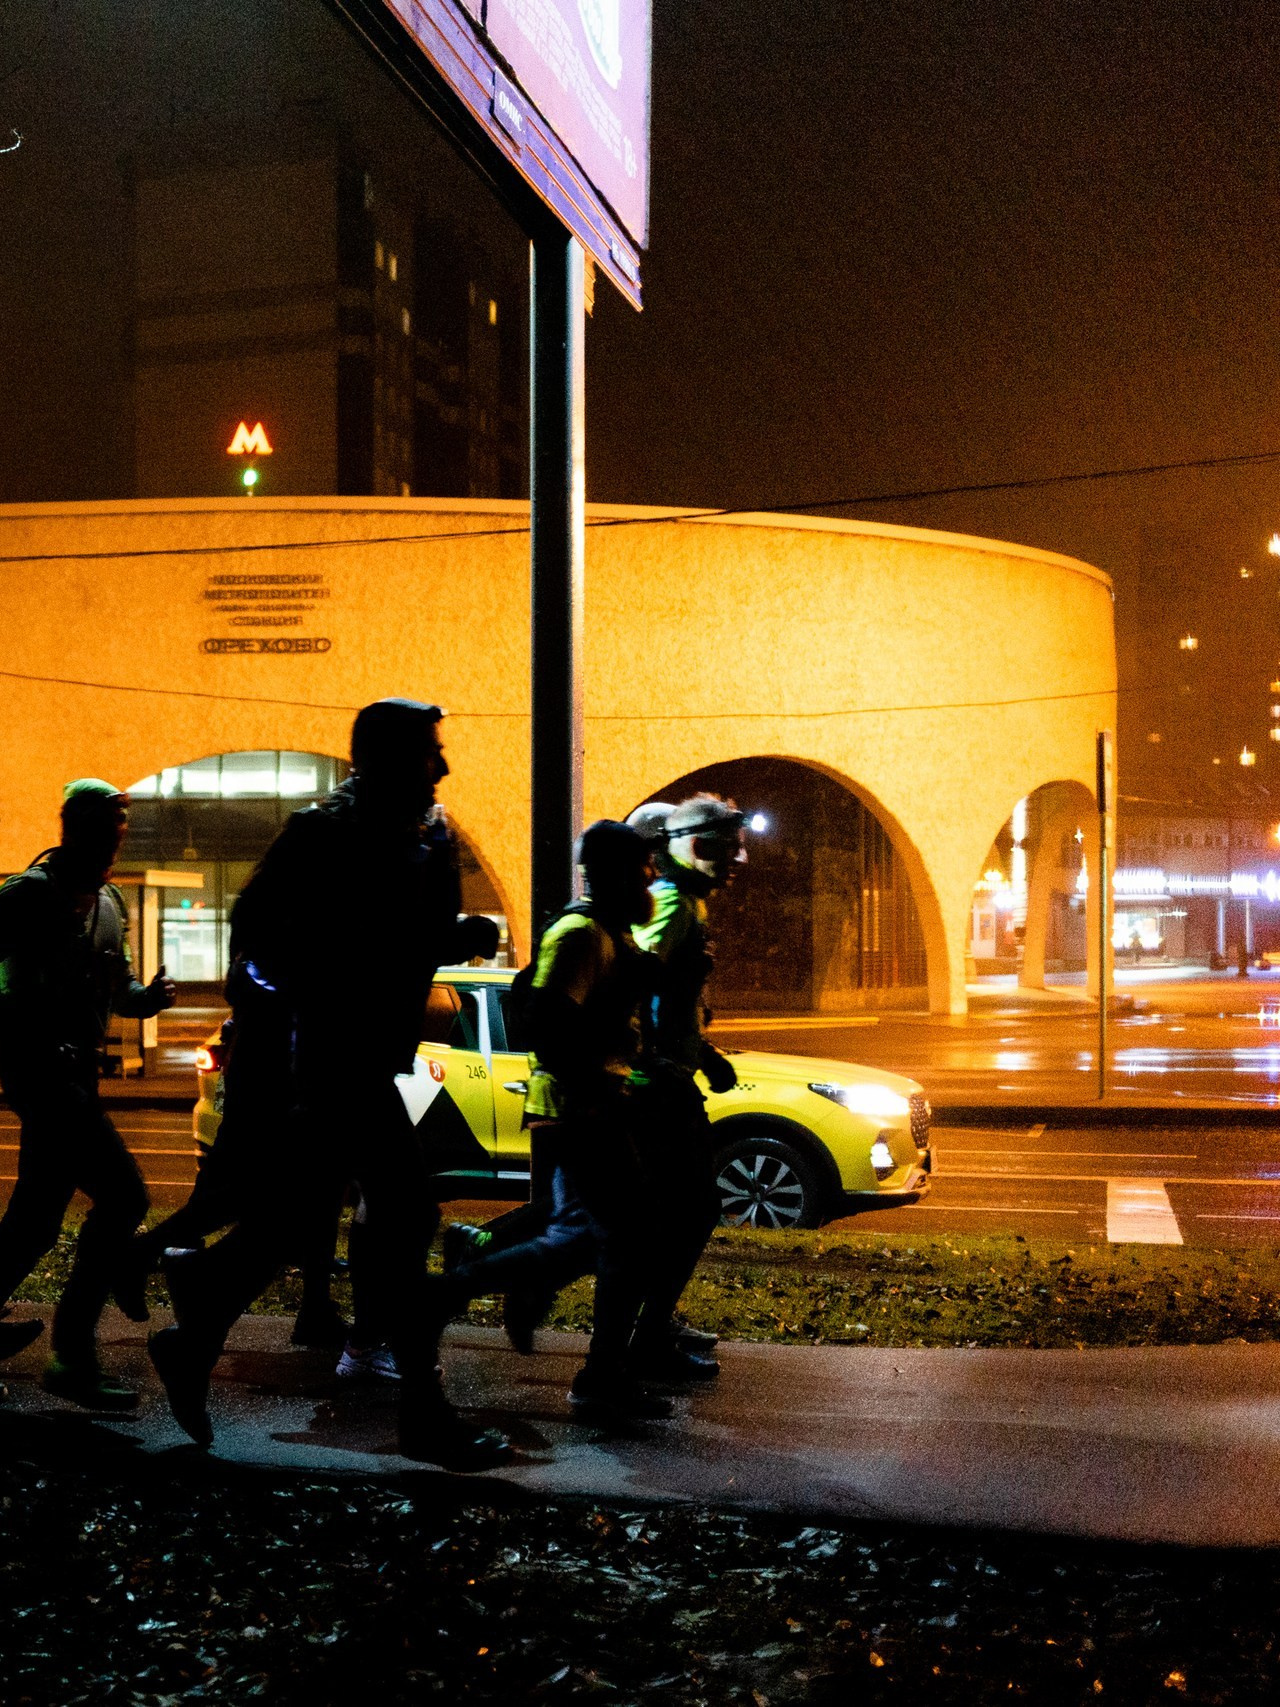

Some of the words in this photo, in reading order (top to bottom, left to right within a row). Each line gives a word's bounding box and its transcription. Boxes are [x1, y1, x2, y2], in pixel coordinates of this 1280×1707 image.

[227, 421, 273, 454] М
[202, 638, 331, 653] ОРЕХОВО
[466, 1065, 487, 1079] 246
